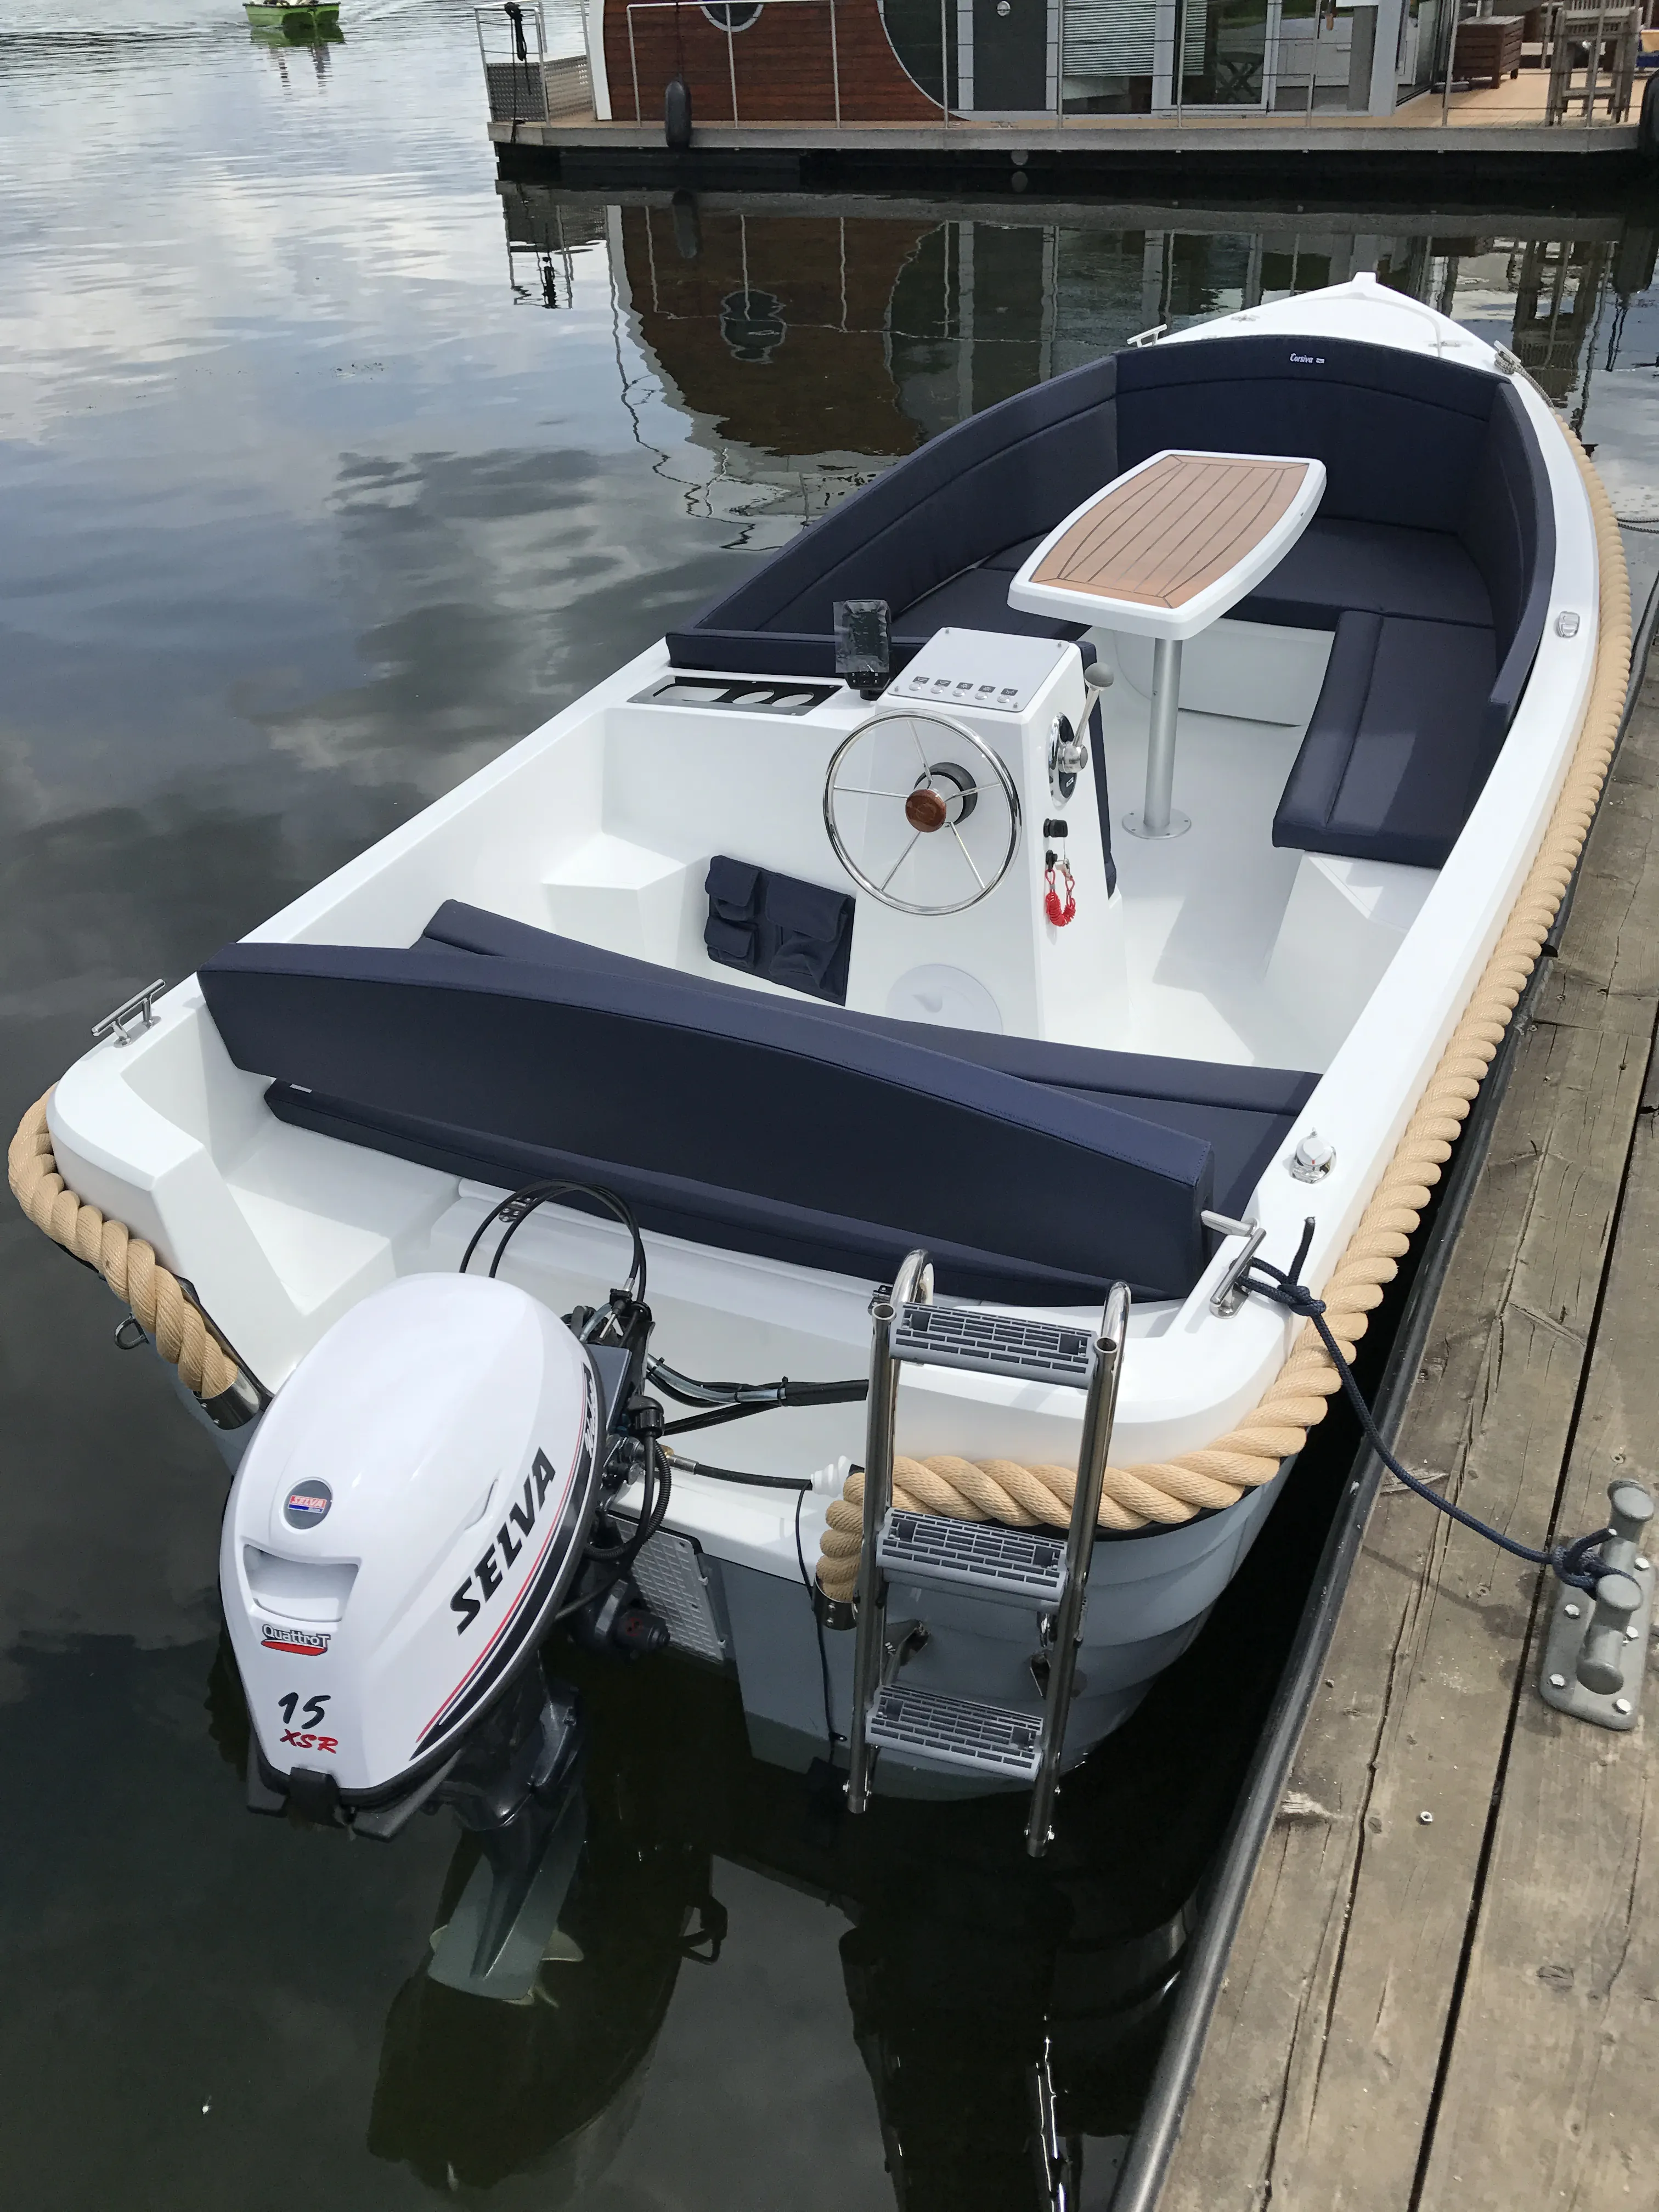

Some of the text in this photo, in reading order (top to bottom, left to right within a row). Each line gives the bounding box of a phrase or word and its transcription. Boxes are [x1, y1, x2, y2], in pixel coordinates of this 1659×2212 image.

[1290, 353, 1313, 363] Corsiva
[291, 1497, 324, 1508] SELVA
[450, 1446, 556, 1637] SELVA
[278, 1692, 331, 1730] 15
[280, 1729, 338, 1754] XSR
